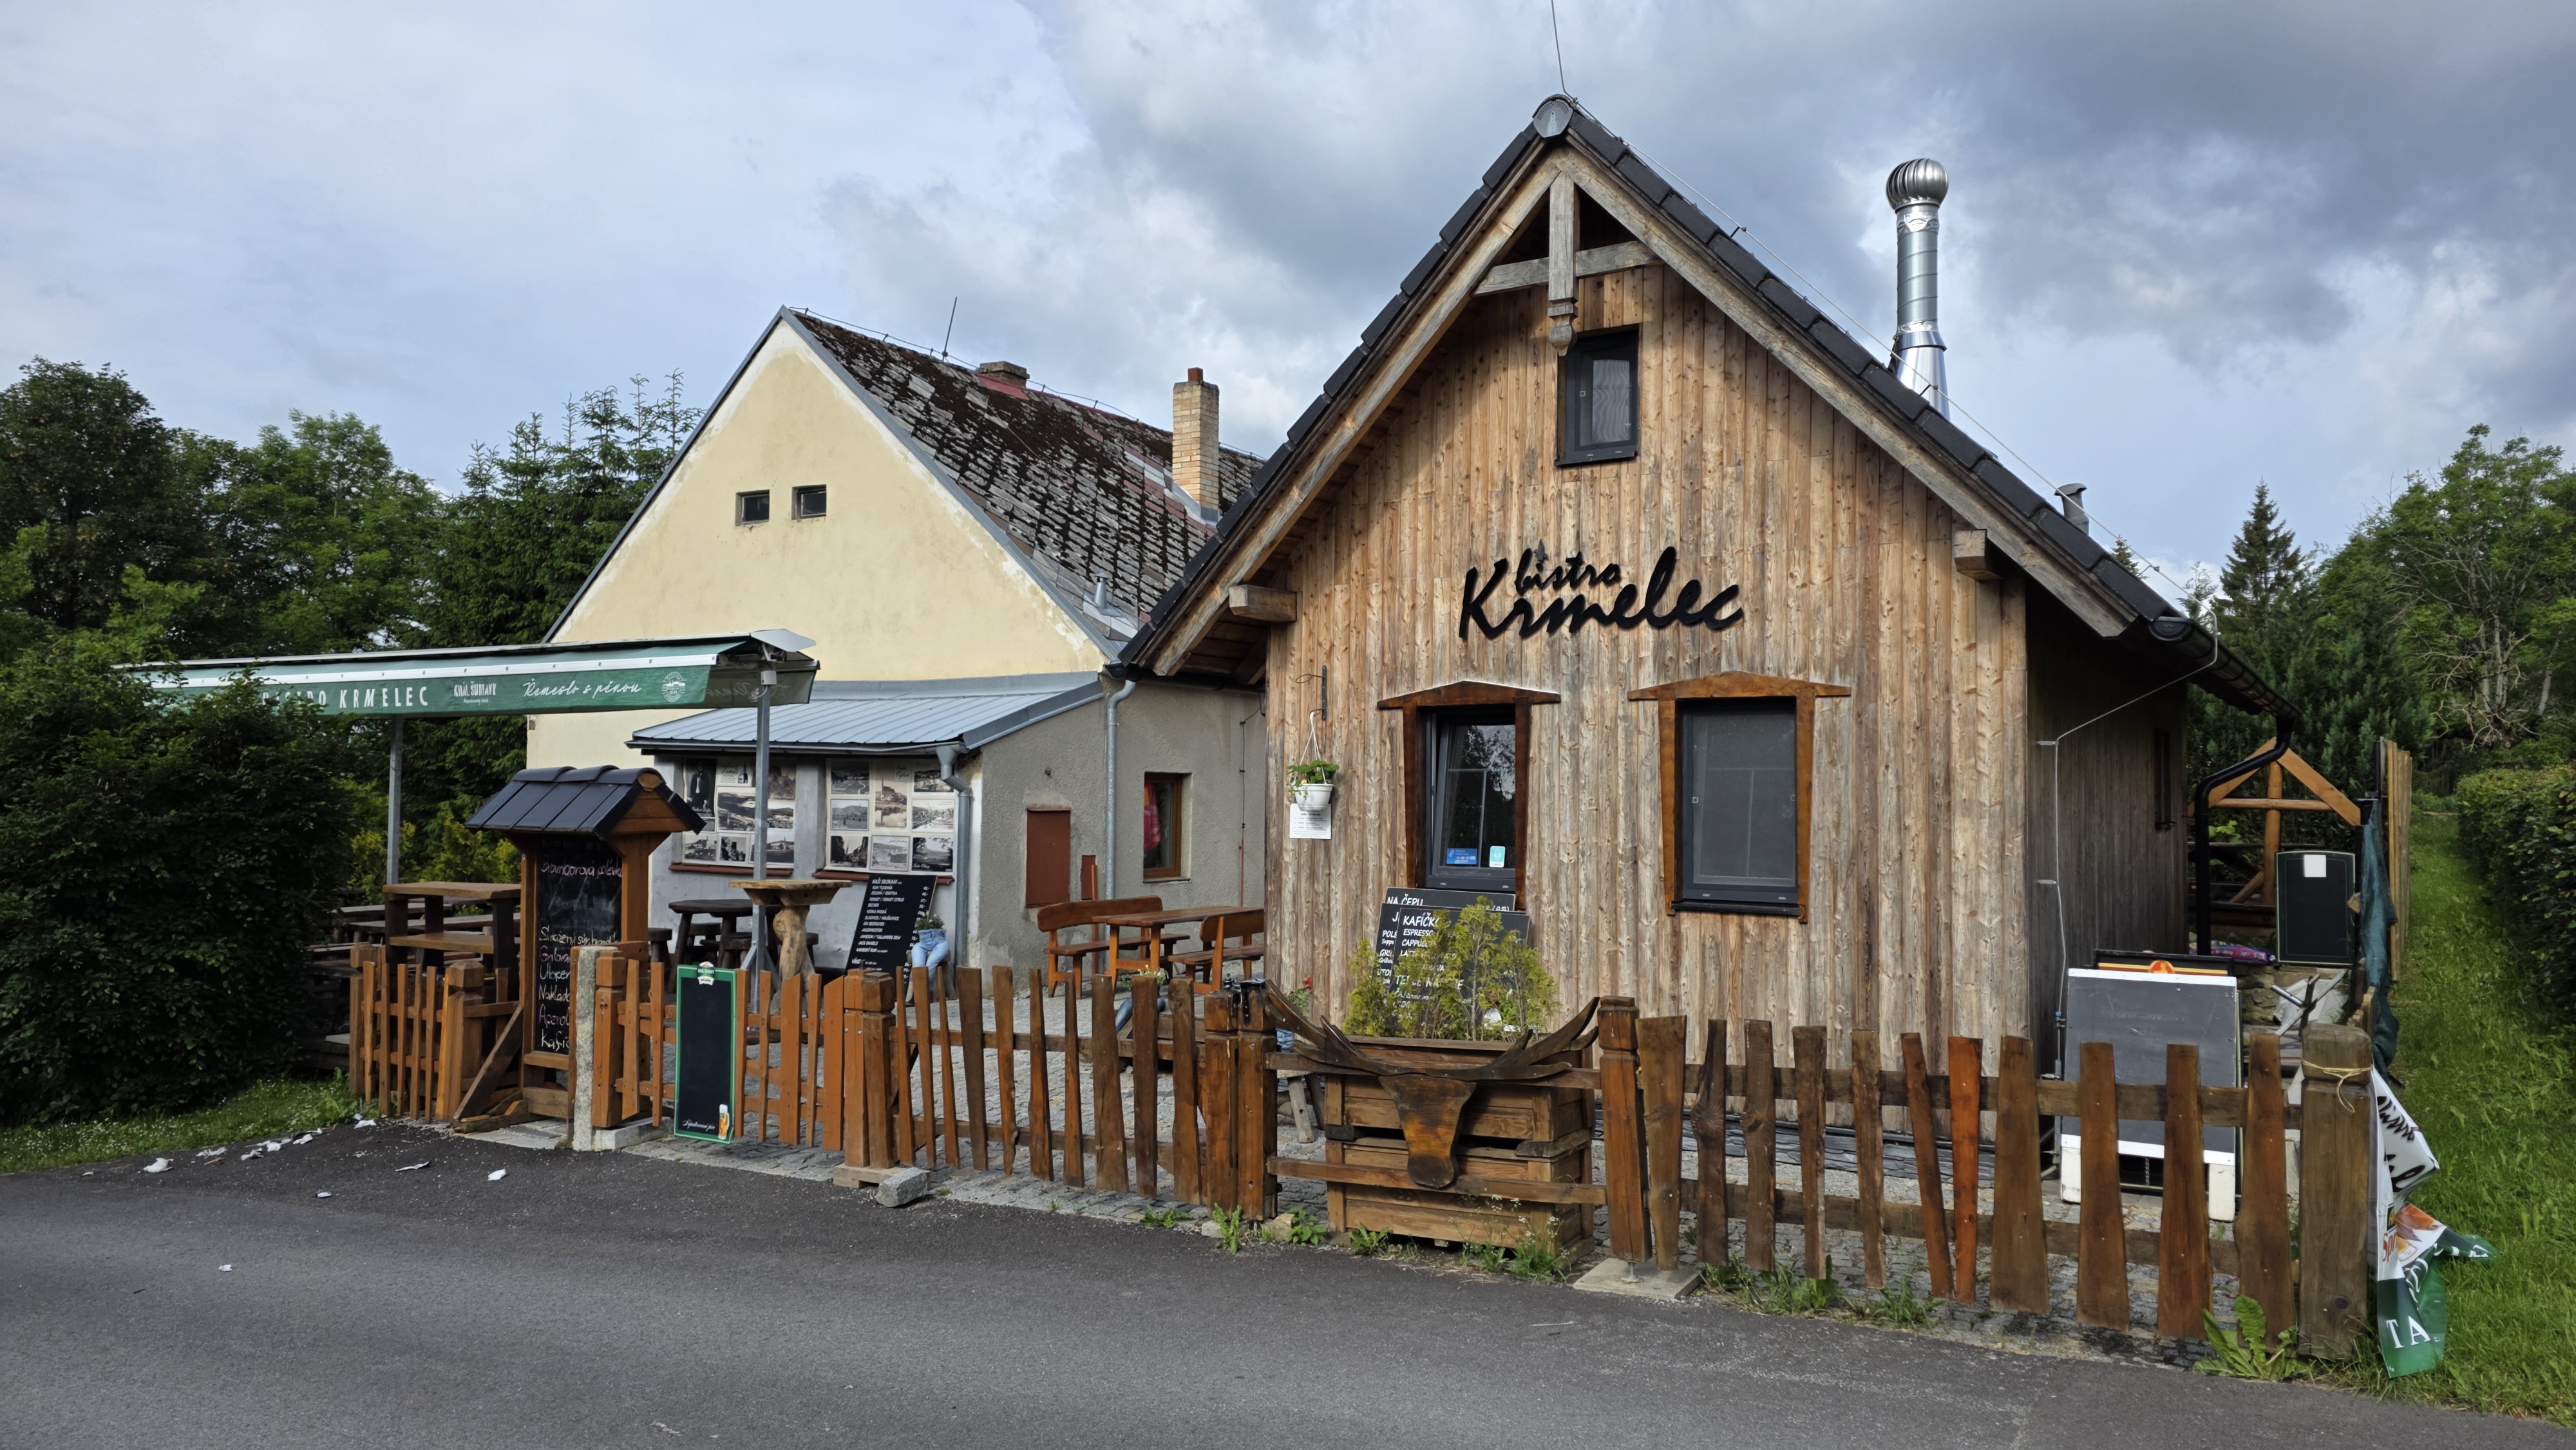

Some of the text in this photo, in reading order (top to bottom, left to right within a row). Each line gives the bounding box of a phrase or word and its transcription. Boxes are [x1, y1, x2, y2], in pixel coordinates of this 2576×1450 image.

[1515, 548, 1621, 594] bistro
[1459, 546, 1744, 639] Krmelec
[339, 686, 428, 708] KRMELEC
[454, 681, 497, 697] KRÁL ŠUMAVY
[522, 678, 580, 697] Řemeslo
[592, 681, 642, 699] pěnou
[542, 857, 594, 877] Bramborová
[1387, 896, 1399, 905] NA
[540, 946, 571, 963] Grilova
